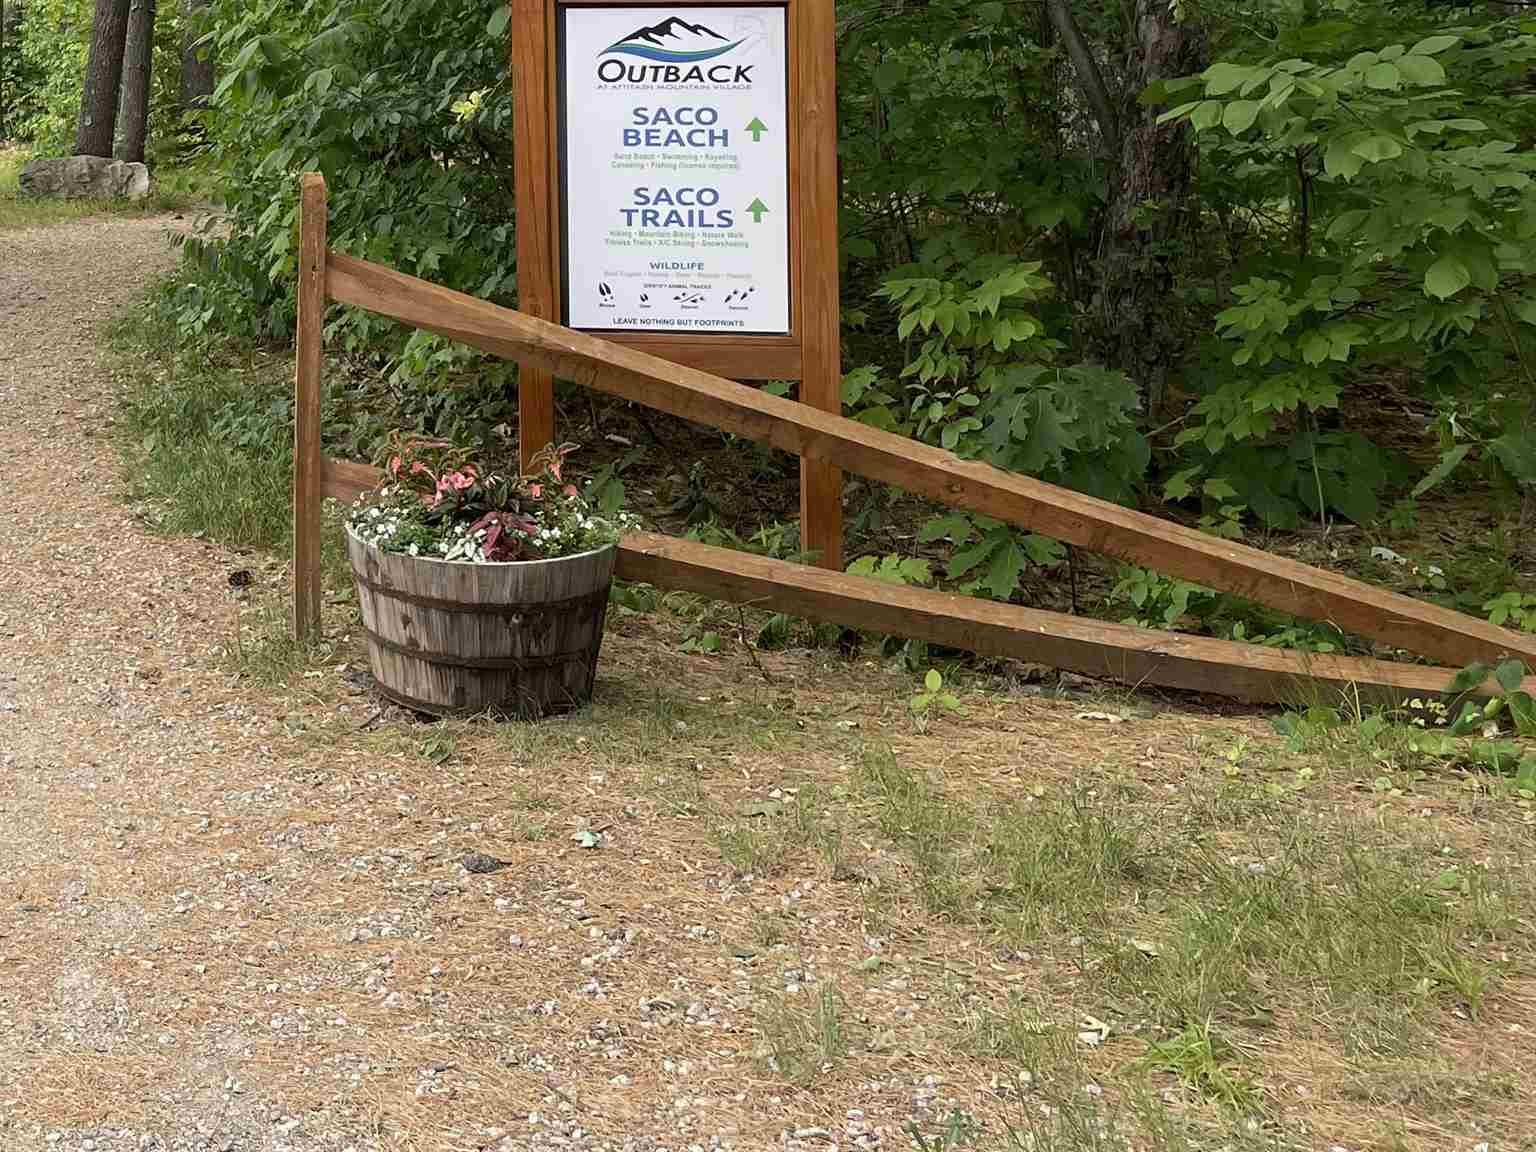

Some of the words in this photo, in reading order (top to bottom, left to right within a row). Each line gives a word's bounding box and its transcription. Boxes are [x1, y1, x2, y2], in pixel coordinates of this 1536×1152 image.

[632, 107, 719, 126] SACO
[622, 128, 730, 148] BEACH
[633, 187, 720, 206] SACO
[619, 209, 734, 228] TRAILS
[649, 262, 705, 271] WILDLIFE
[613, 318, 637, 326] LEAVE
[639, 318, 675, 326] NOTHING
[677, 318, 693, 326] BUT
[694, 318, 745, 326] FOOTPRINTS
